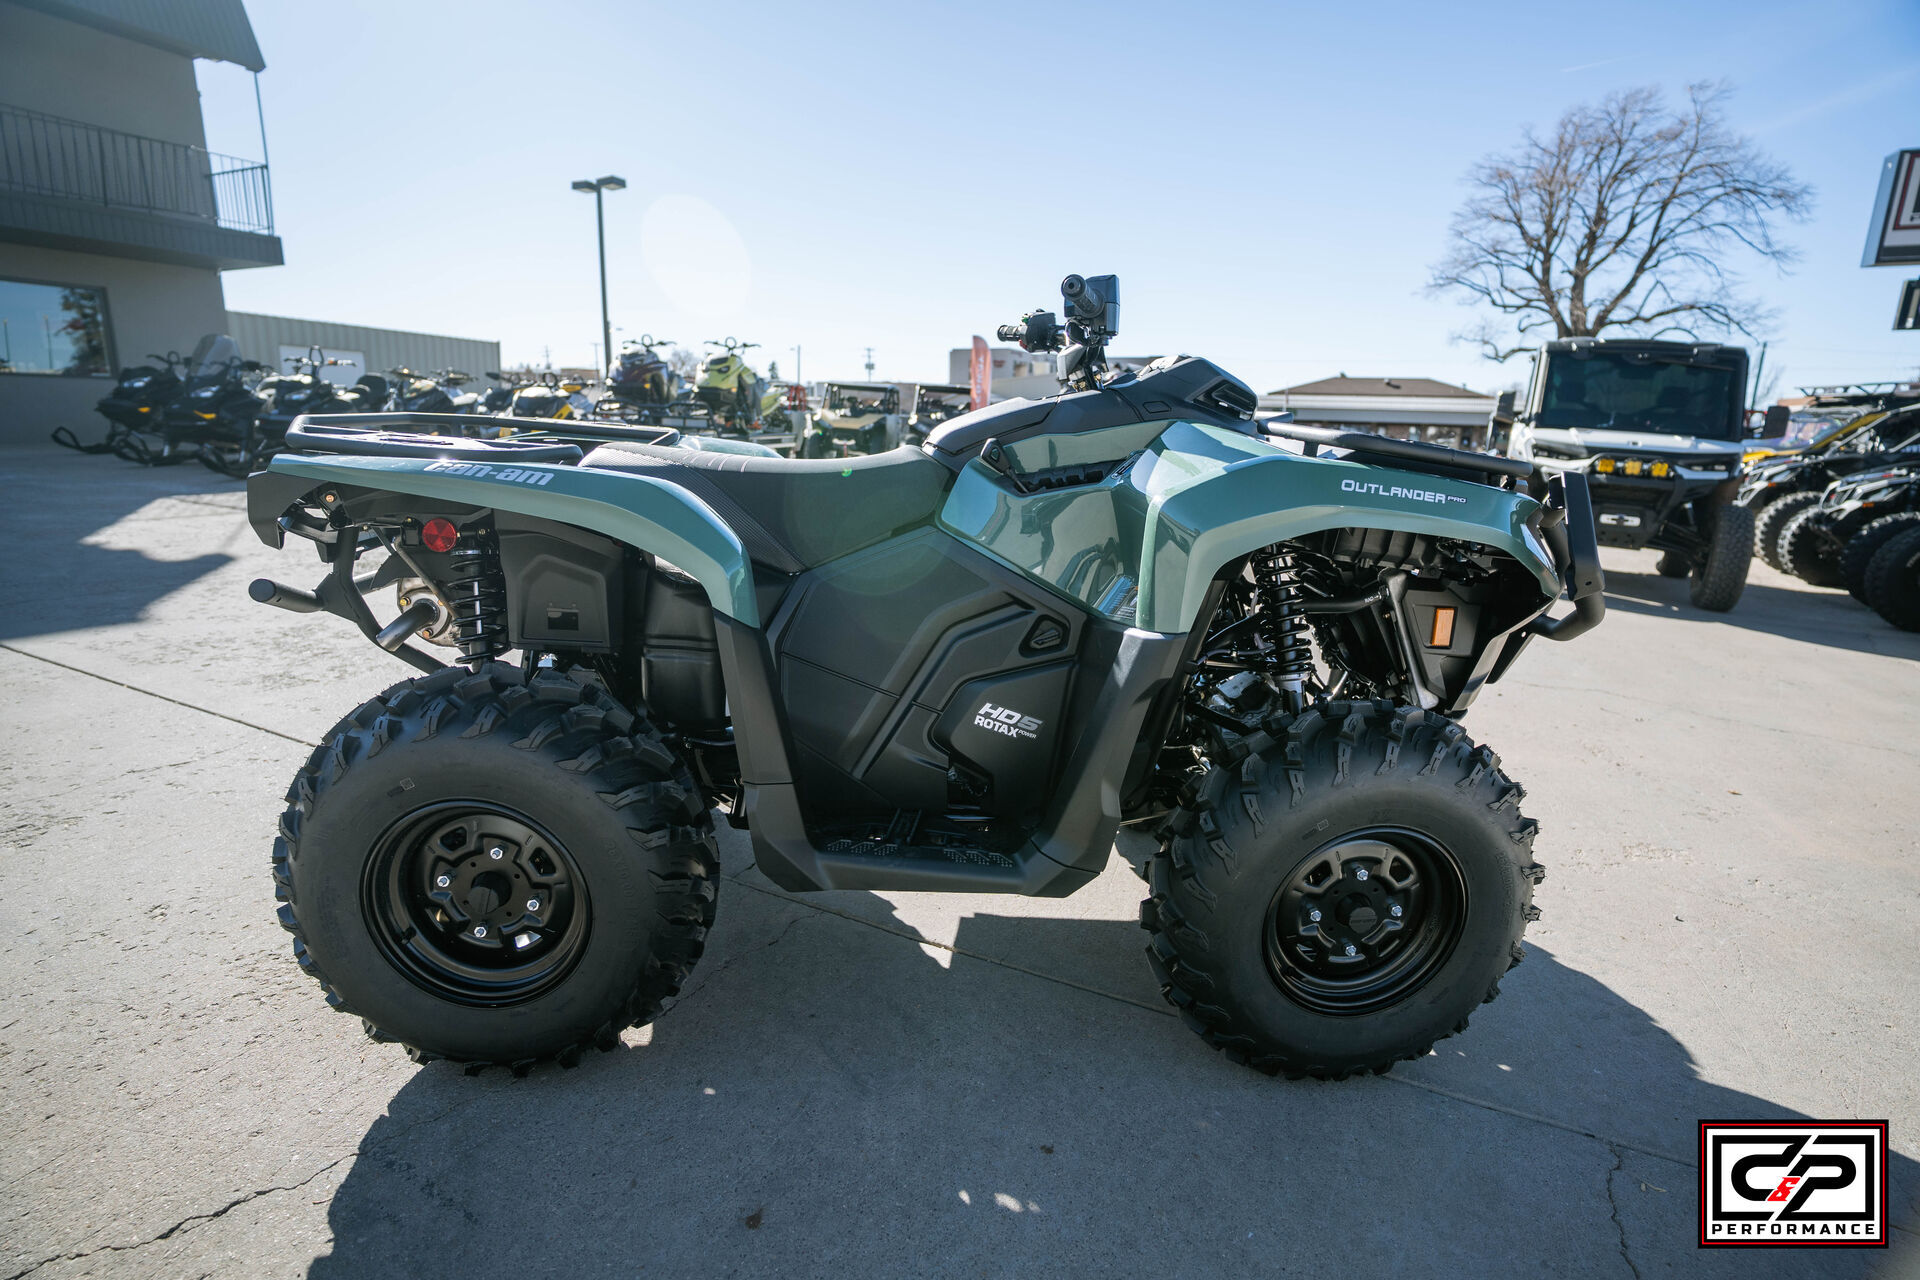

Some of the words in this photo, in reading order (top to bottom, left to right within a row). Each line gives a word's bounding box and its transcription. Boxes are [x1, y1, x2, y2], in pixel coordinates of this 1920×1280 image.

[1341, 479, 1446, 504] OUTLANDER
[1447, 495, 1467, 504] PRO
[974, 715, 1020, 738] ROTAX
[1018, 729, 1037, 739] POWER
